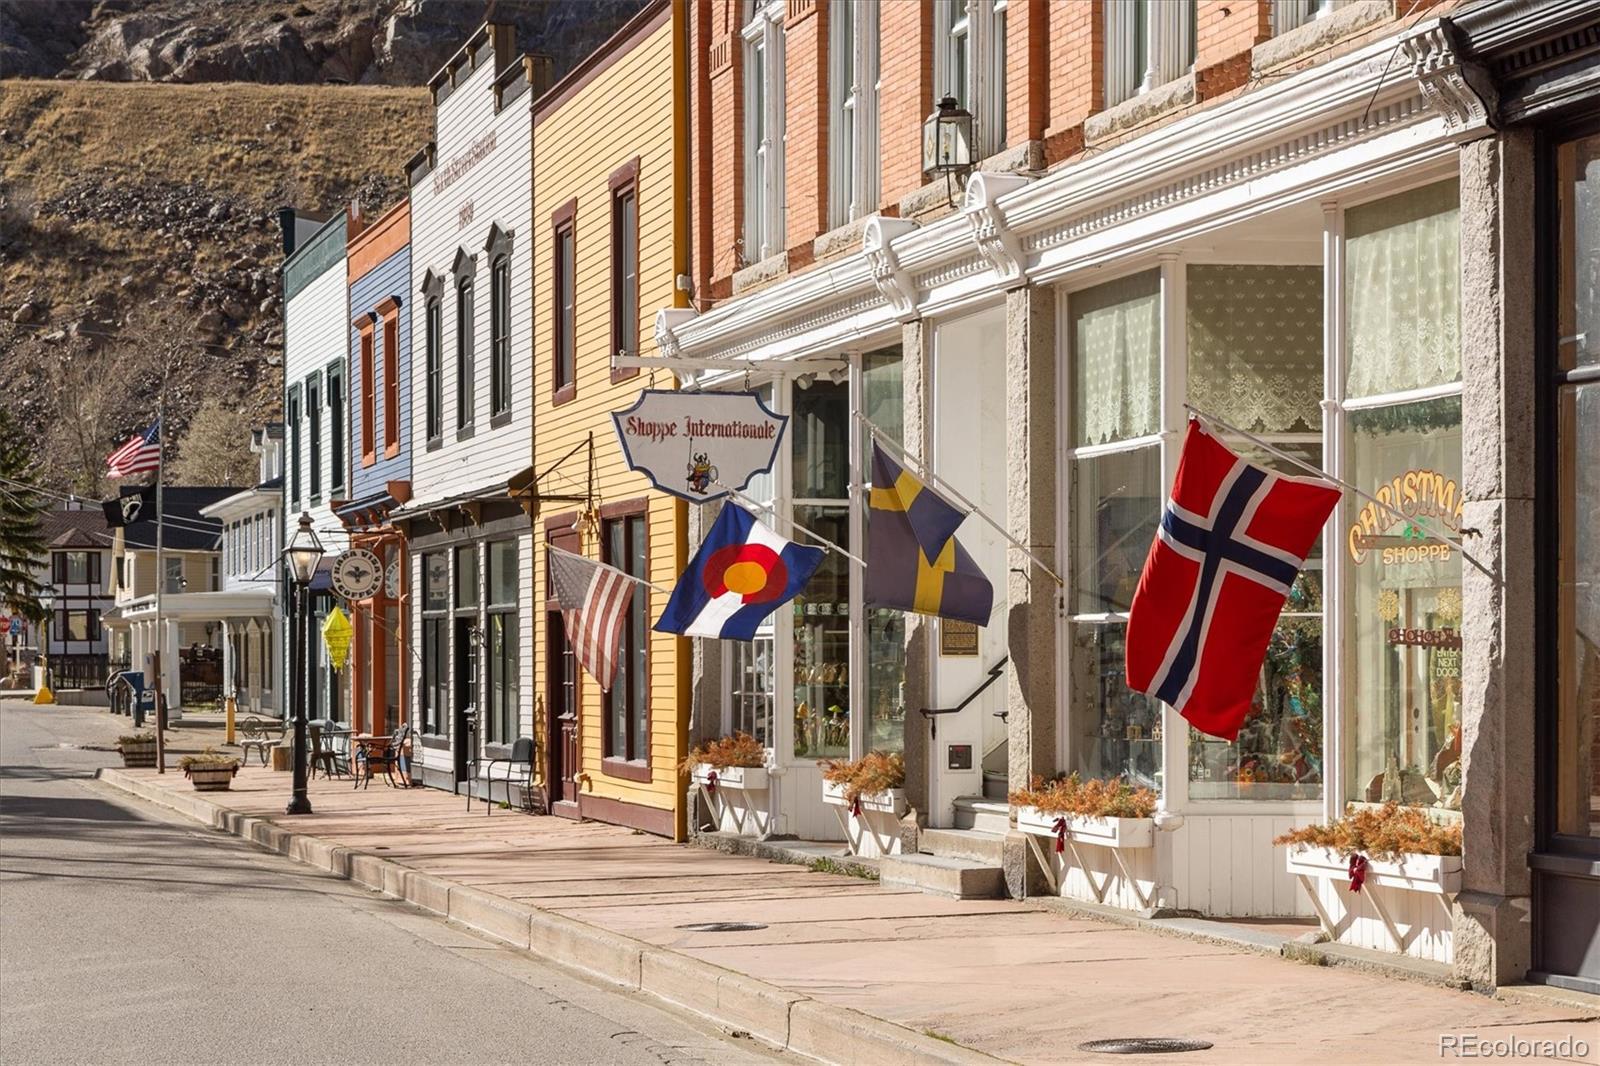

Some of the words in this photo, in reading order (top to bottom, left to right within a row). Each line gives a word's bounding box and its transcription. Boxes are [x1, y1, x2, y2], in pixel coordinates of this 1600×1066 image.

[626, 415, 678, 443] Shoppe
[682, 415, 776, 441] Internationale
[1349, 469, 1463, 565] CHRISTMA
[1382, 544, 1452, 565] SHOPPE
[337, 583, 379, 598] COFFEE
[1437, 657, 1457, 668] NEXT
[1436, 667, 1459, 677] DOOR
